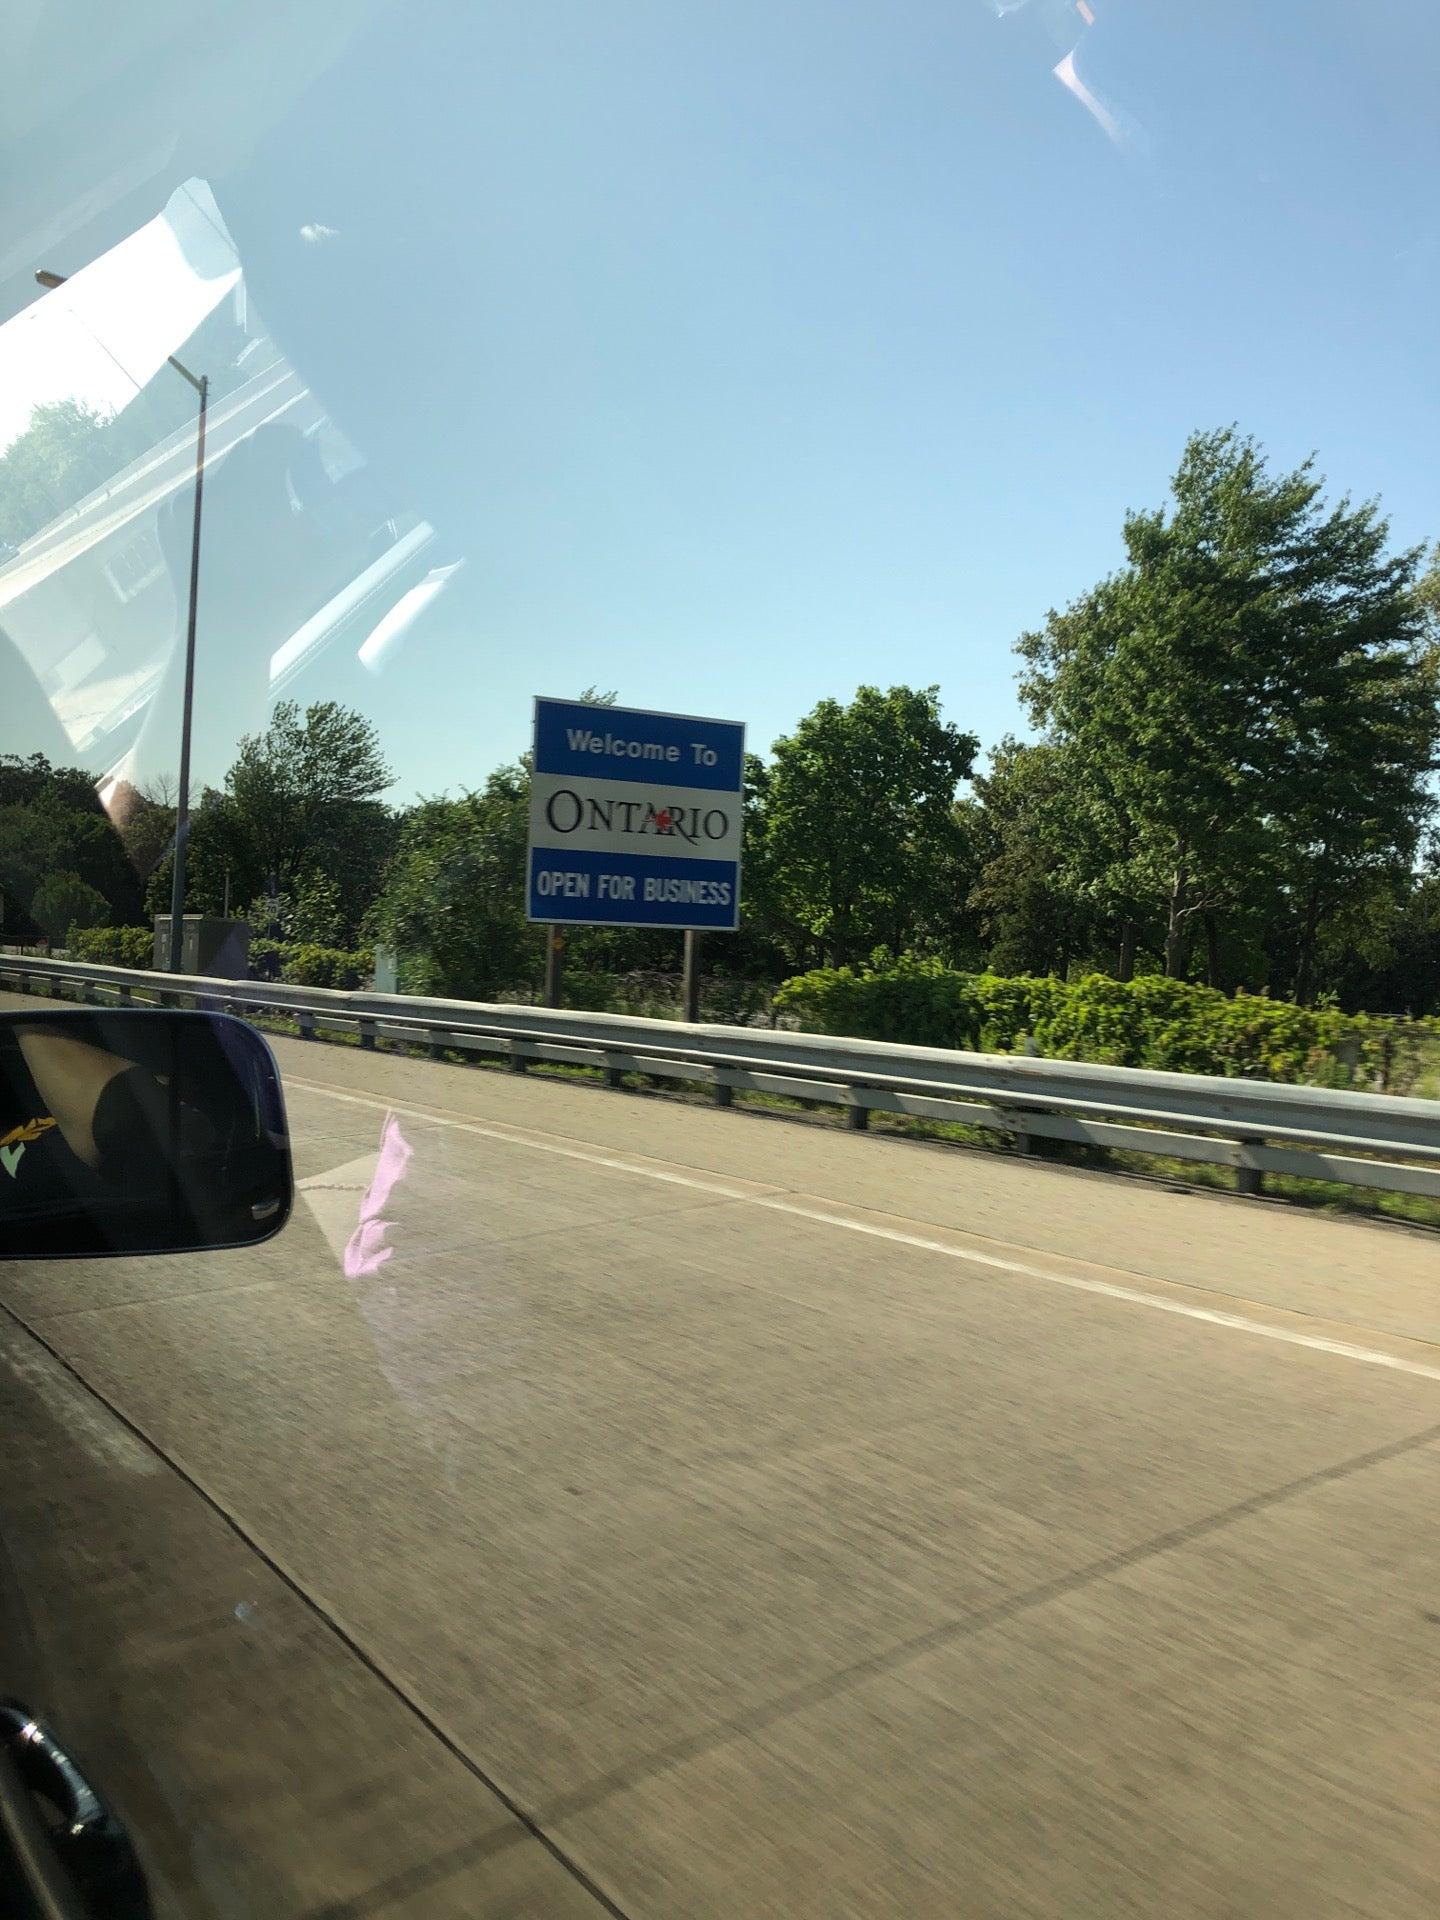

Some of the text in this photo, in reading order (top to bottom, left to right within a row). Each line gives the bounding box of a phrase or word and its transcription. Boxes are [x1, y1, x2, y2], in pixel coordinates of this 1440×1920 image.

[567, 729, 718, 766] Welcome To
[546, 789, 729, 846] ONTARIO
[537, 871, 731, 905] OPEN FOR BUSINESS
